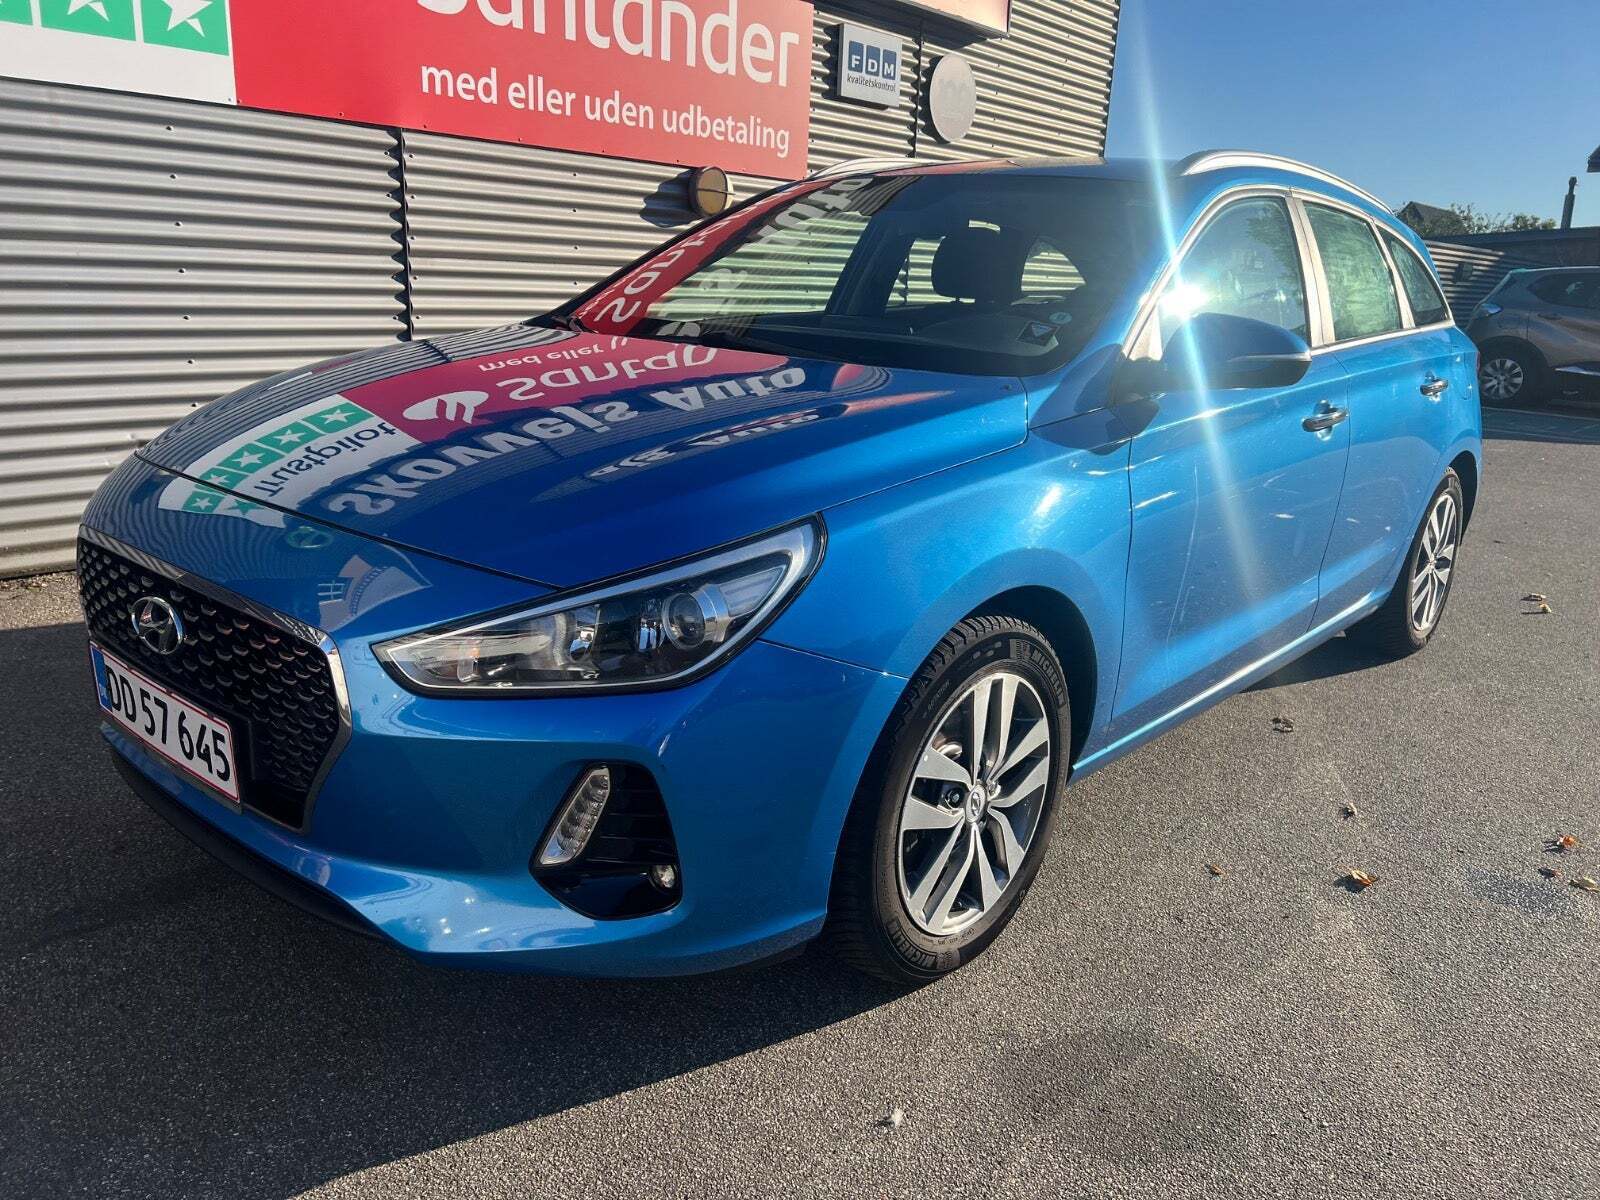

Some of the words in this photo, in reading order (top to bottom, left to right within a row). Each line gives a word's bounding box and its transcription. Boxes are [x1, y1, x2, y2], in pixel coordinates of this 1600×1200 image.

[417, 0, 799, 87] ntander
[851, 55, 895, 77] FDM
[421, 65, 498, 105] med
[507, 74, 576, 117] eller
[584, 90, 654, 129] uden
[662, 104, 790, 158] udbetaling
[847, 73, 896, 92] kvalitetskontrol
[1031, 646, 1067, 706] MICHELIN
[105, 665, 136, 723] DD
[139, 688, 167, 744] 57
[178, 711, 231, 782] 645
